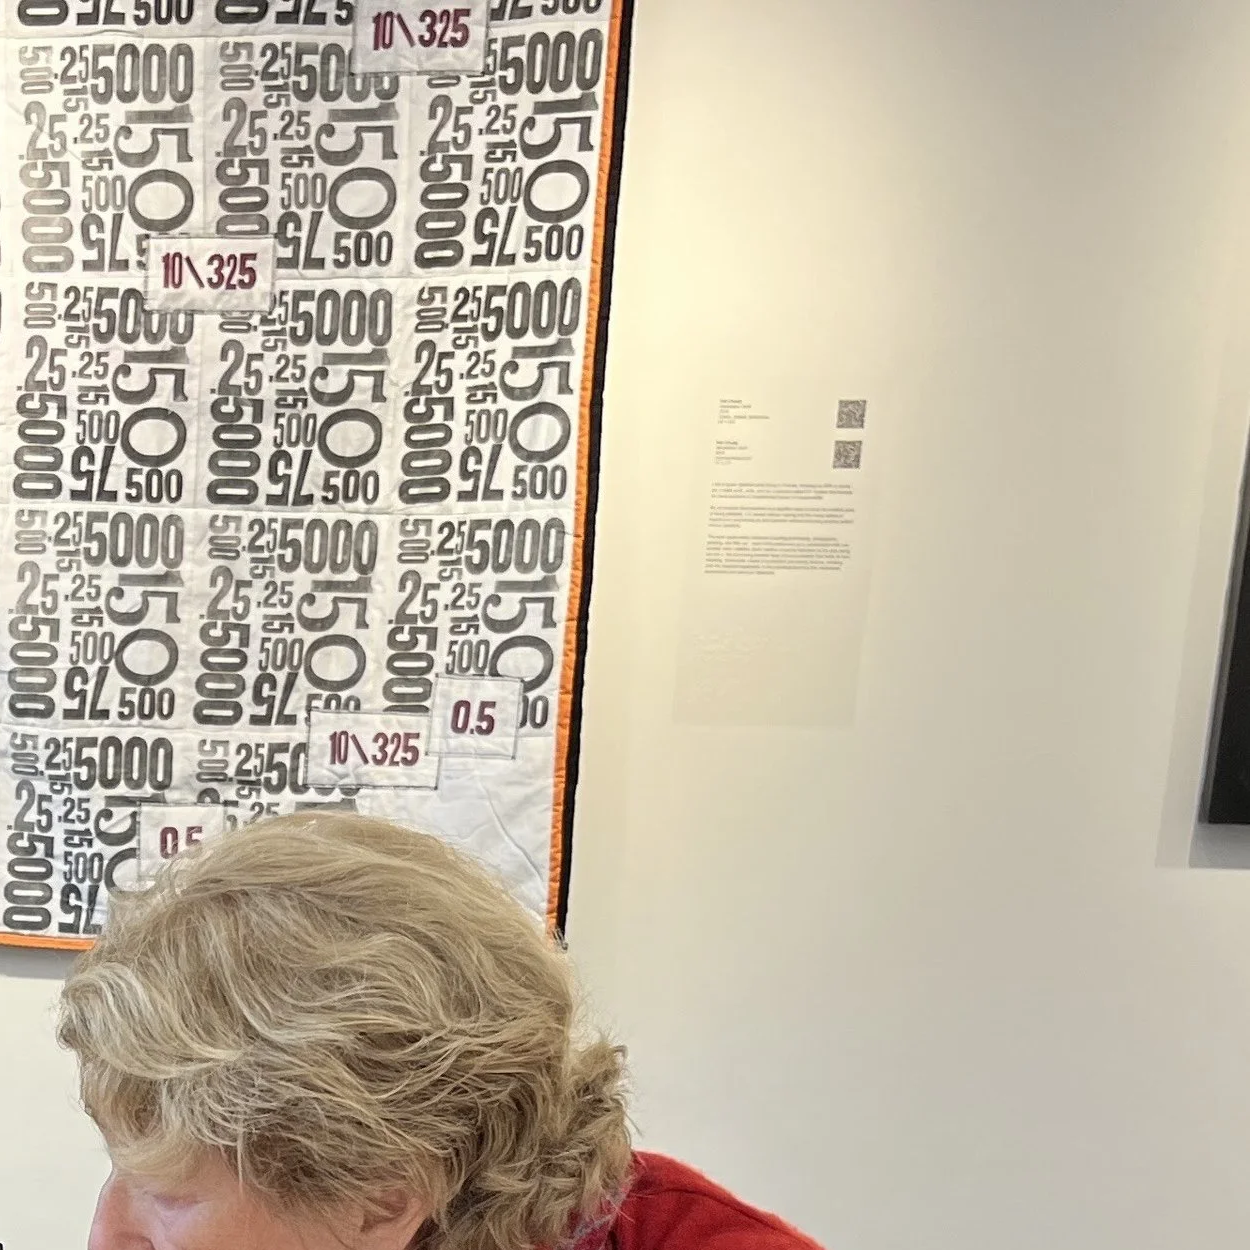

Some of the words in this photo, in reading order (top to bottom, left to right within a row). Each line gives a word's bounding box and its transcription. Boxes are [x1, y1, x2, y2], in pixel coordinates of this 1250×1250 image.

[90, 43, 194, 105] 5000
[497, 28, 603, 97] 5000
[280, 172, 327, 210] 500
[332, 230, 394, 269] 500
[523, 224, 584, 263] 500
[288, 288, 393, 347] 5000
[480, 277, 582, 342] 5000
[273, 410, 317, 449] 500
[125, 467, 183, 504] 500
[320, 468, 380, 510] 500
[511, 464, 567, 500] 500
[83, 511, 185, 569] 5000
[277, 518, 379, 576] 5000
[464, 517, 568, 575] 5000
[73, 631, 114, 665] 500
[258, 637, 303, 672] 500
[445, 639, 490, 676] 500
[117, 686, 175, 721] 500
[450, 699, 498, 736] 0.5
[73, 735, 179, 791] 5000
